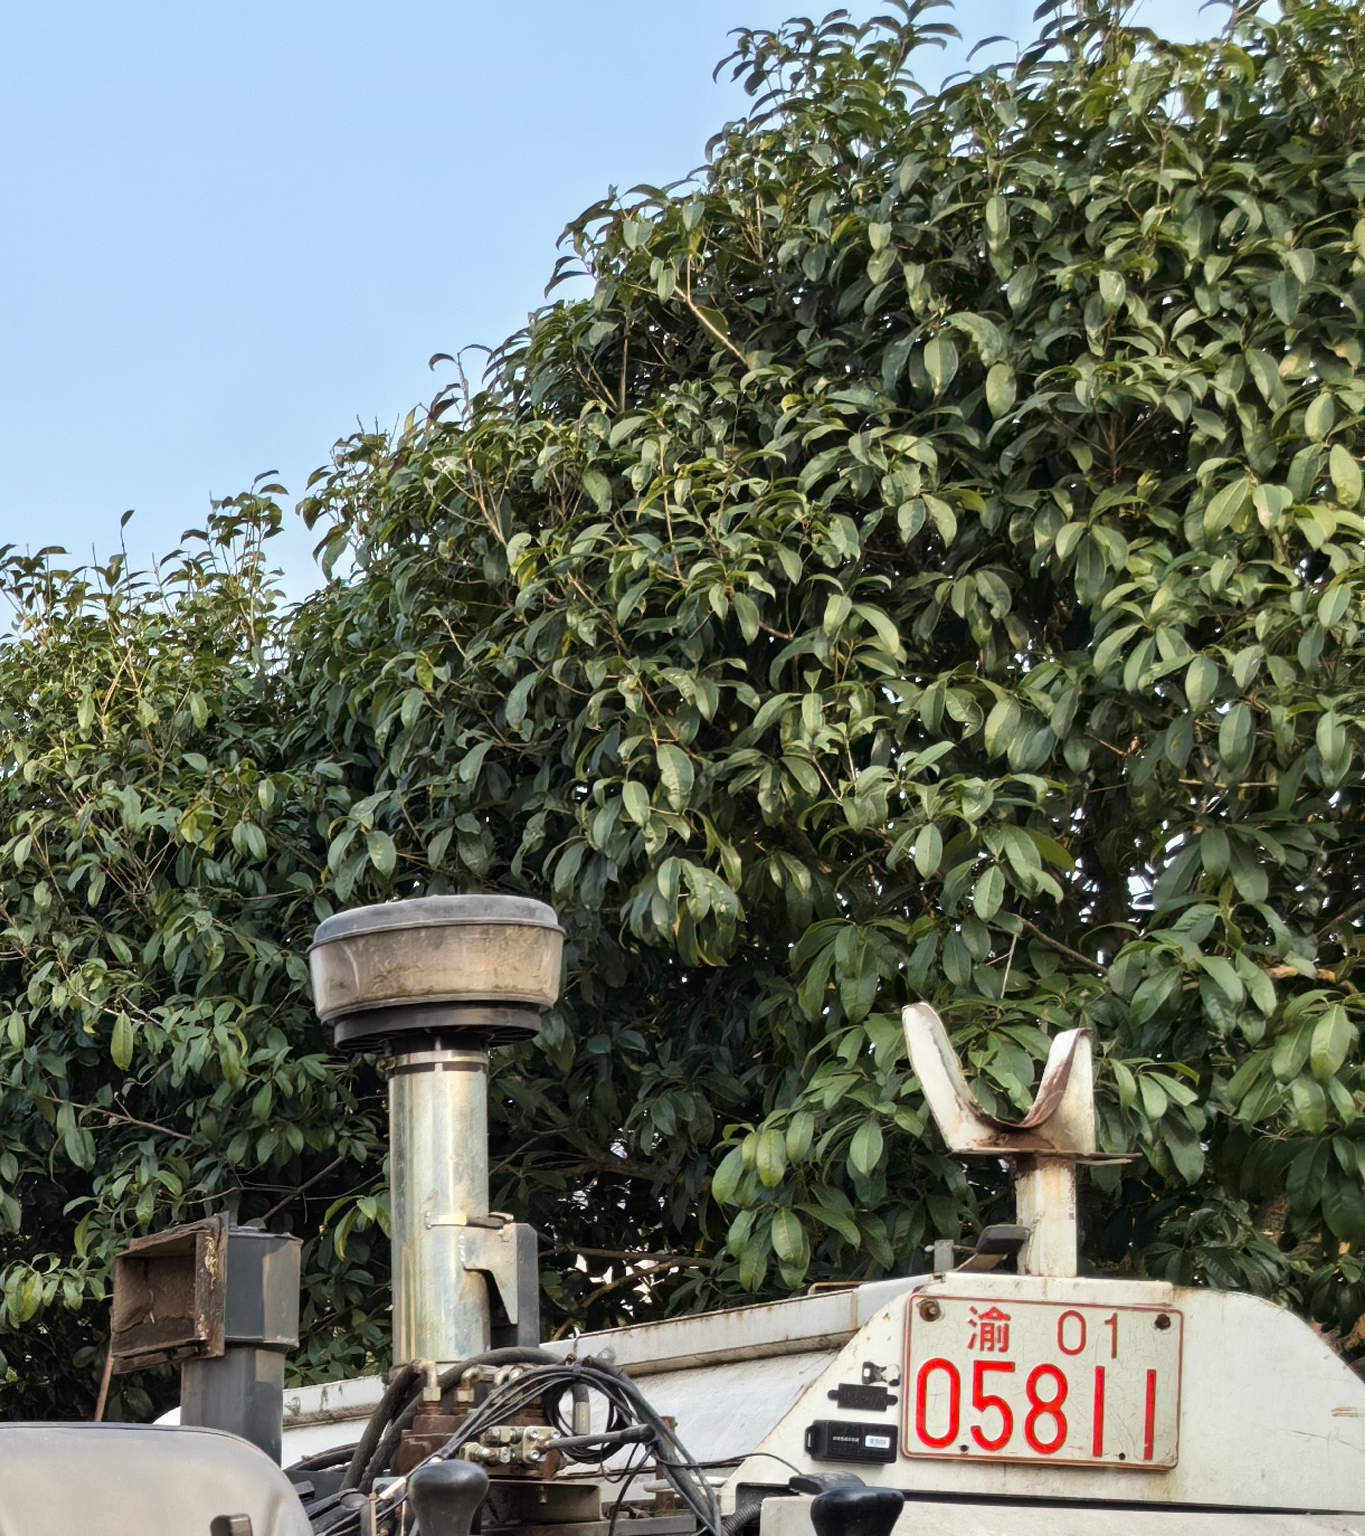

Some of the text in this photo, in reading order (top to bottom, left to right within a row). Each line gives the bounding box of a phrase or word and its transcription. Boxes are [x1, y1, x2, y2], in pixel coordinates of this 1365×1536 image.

[967, 1306, 1118, 1359] 渝 01
[916, 1357, 1156, 1461] 05811
